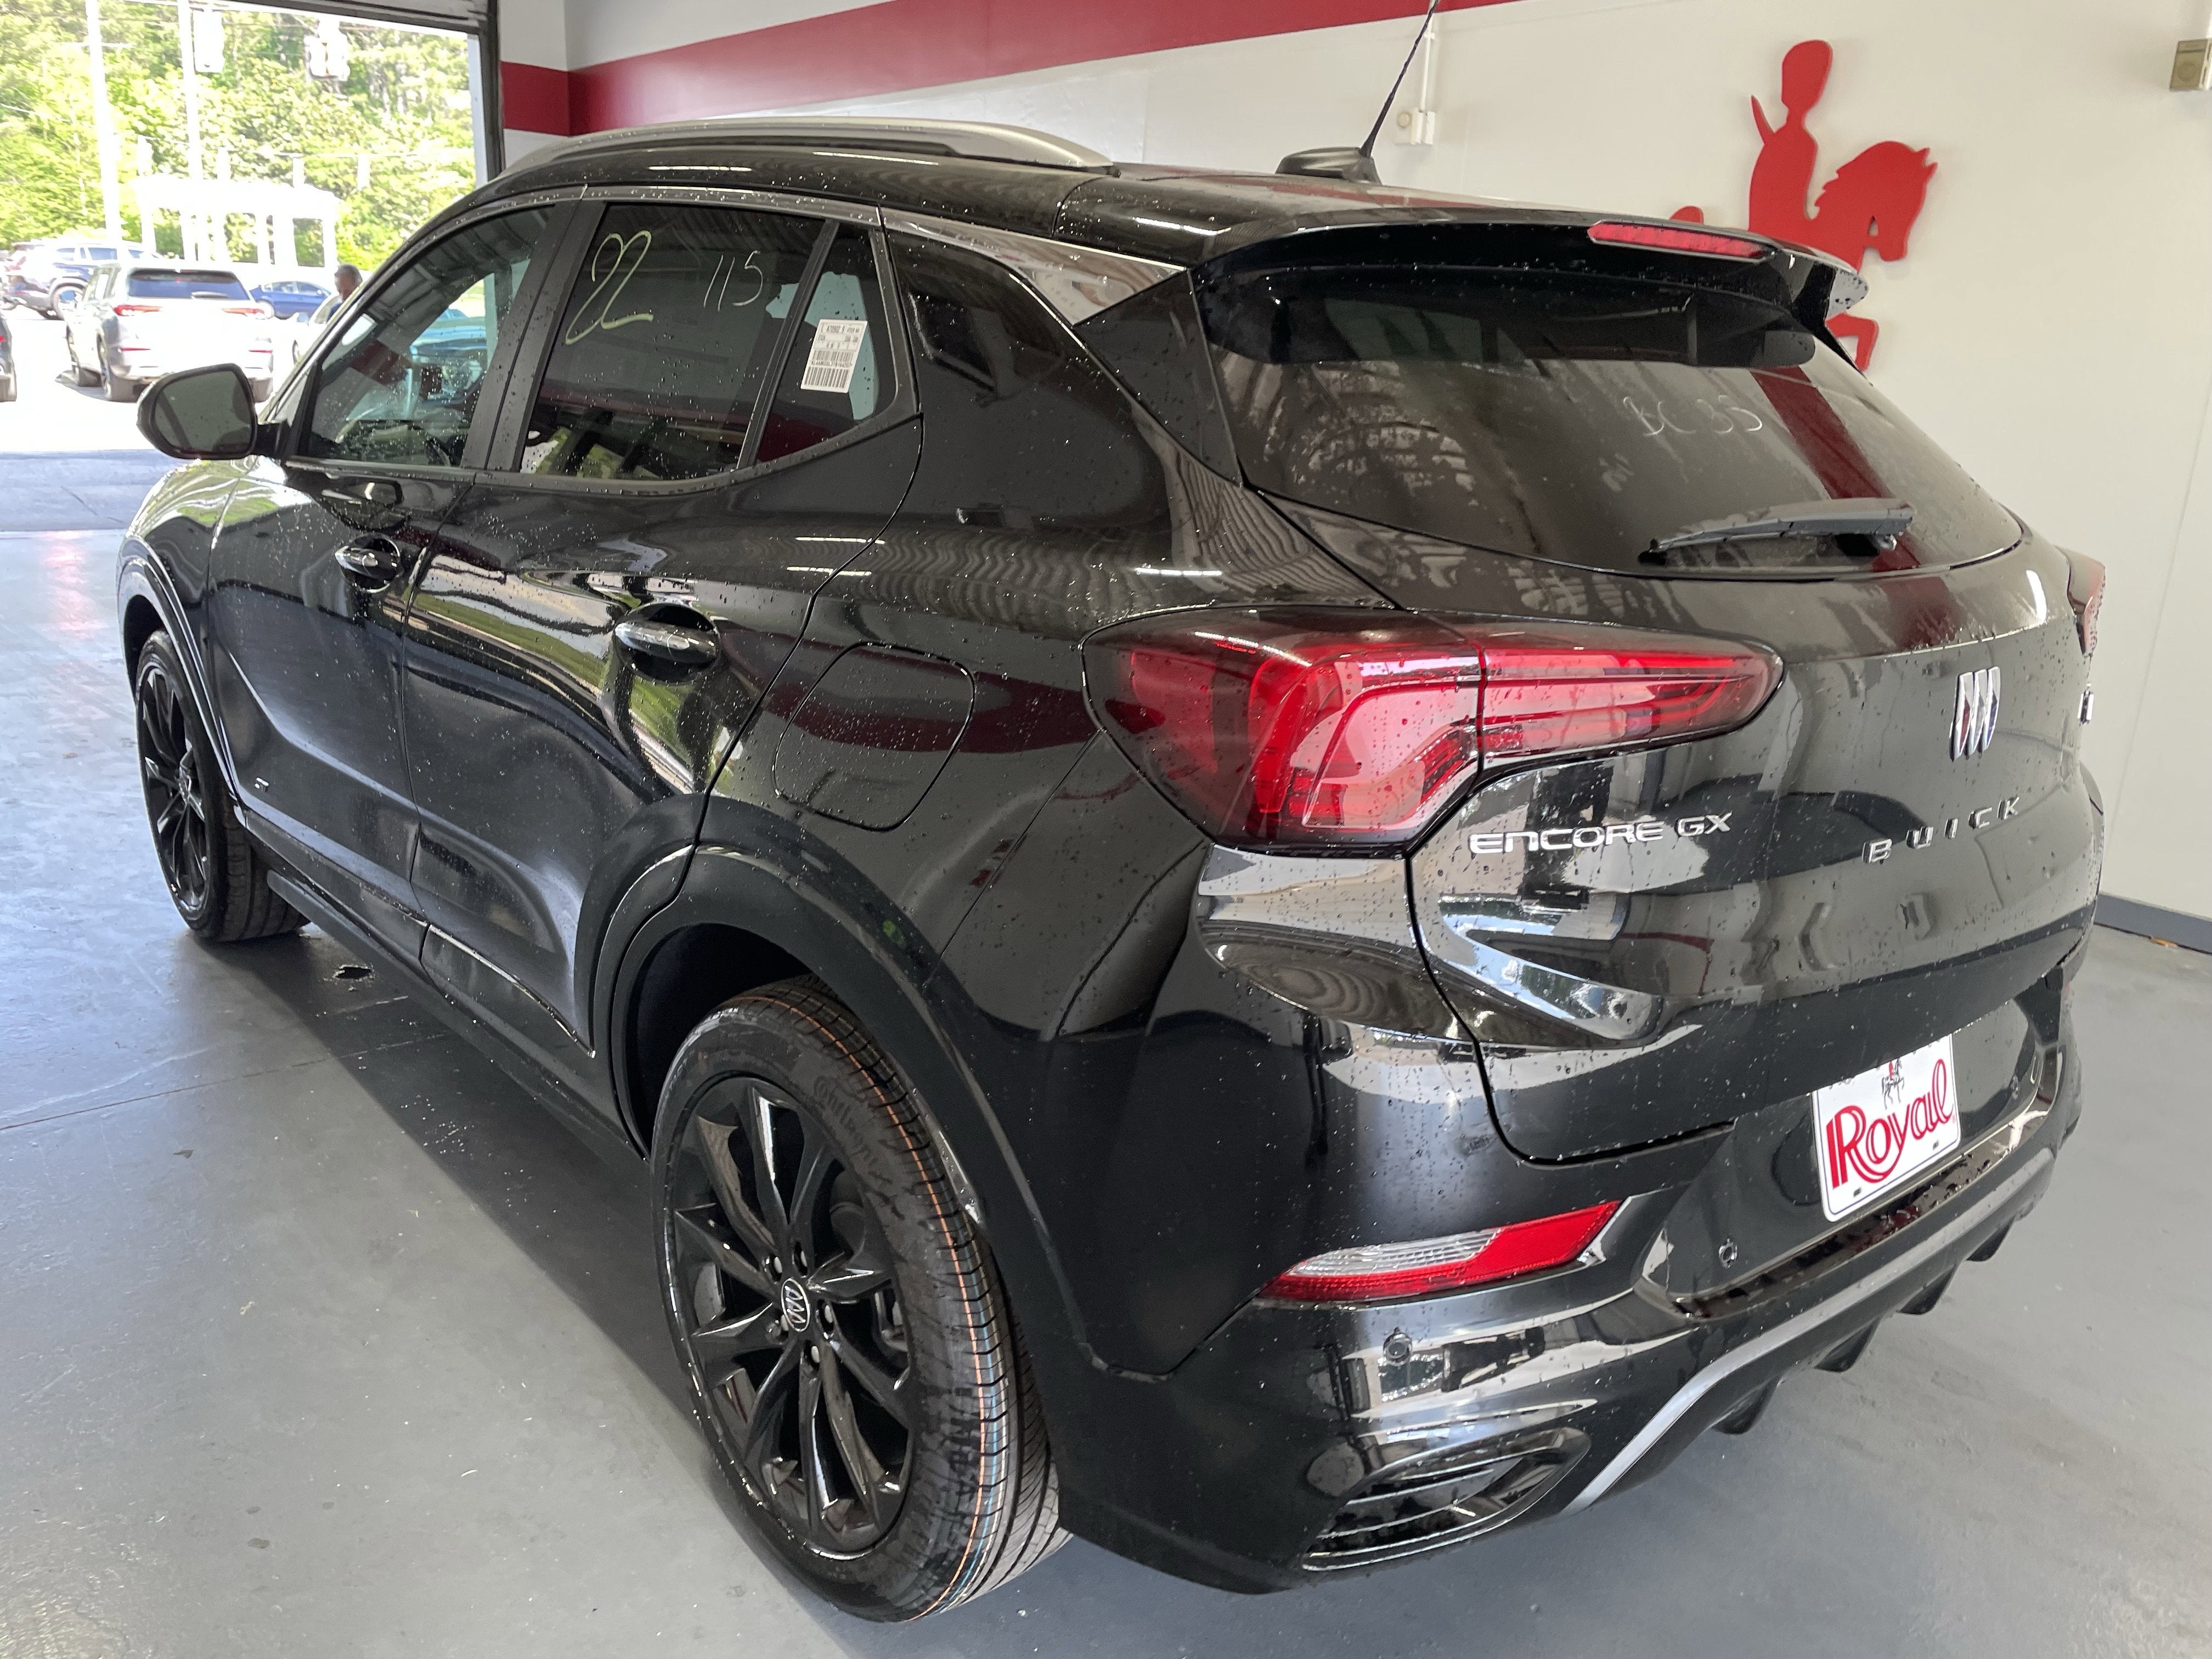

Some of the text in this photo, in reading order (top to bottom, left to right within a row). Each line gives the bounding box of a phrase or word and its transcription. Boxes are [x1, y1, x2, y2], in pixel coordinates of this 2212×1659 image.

[703, 250, 764, 312] 115
[1469, 810, 1733, 854] ENCORE GX
[1862, 797, 2019, 864] BUICK
[1826, 1058, 1954, 1190] Royal
